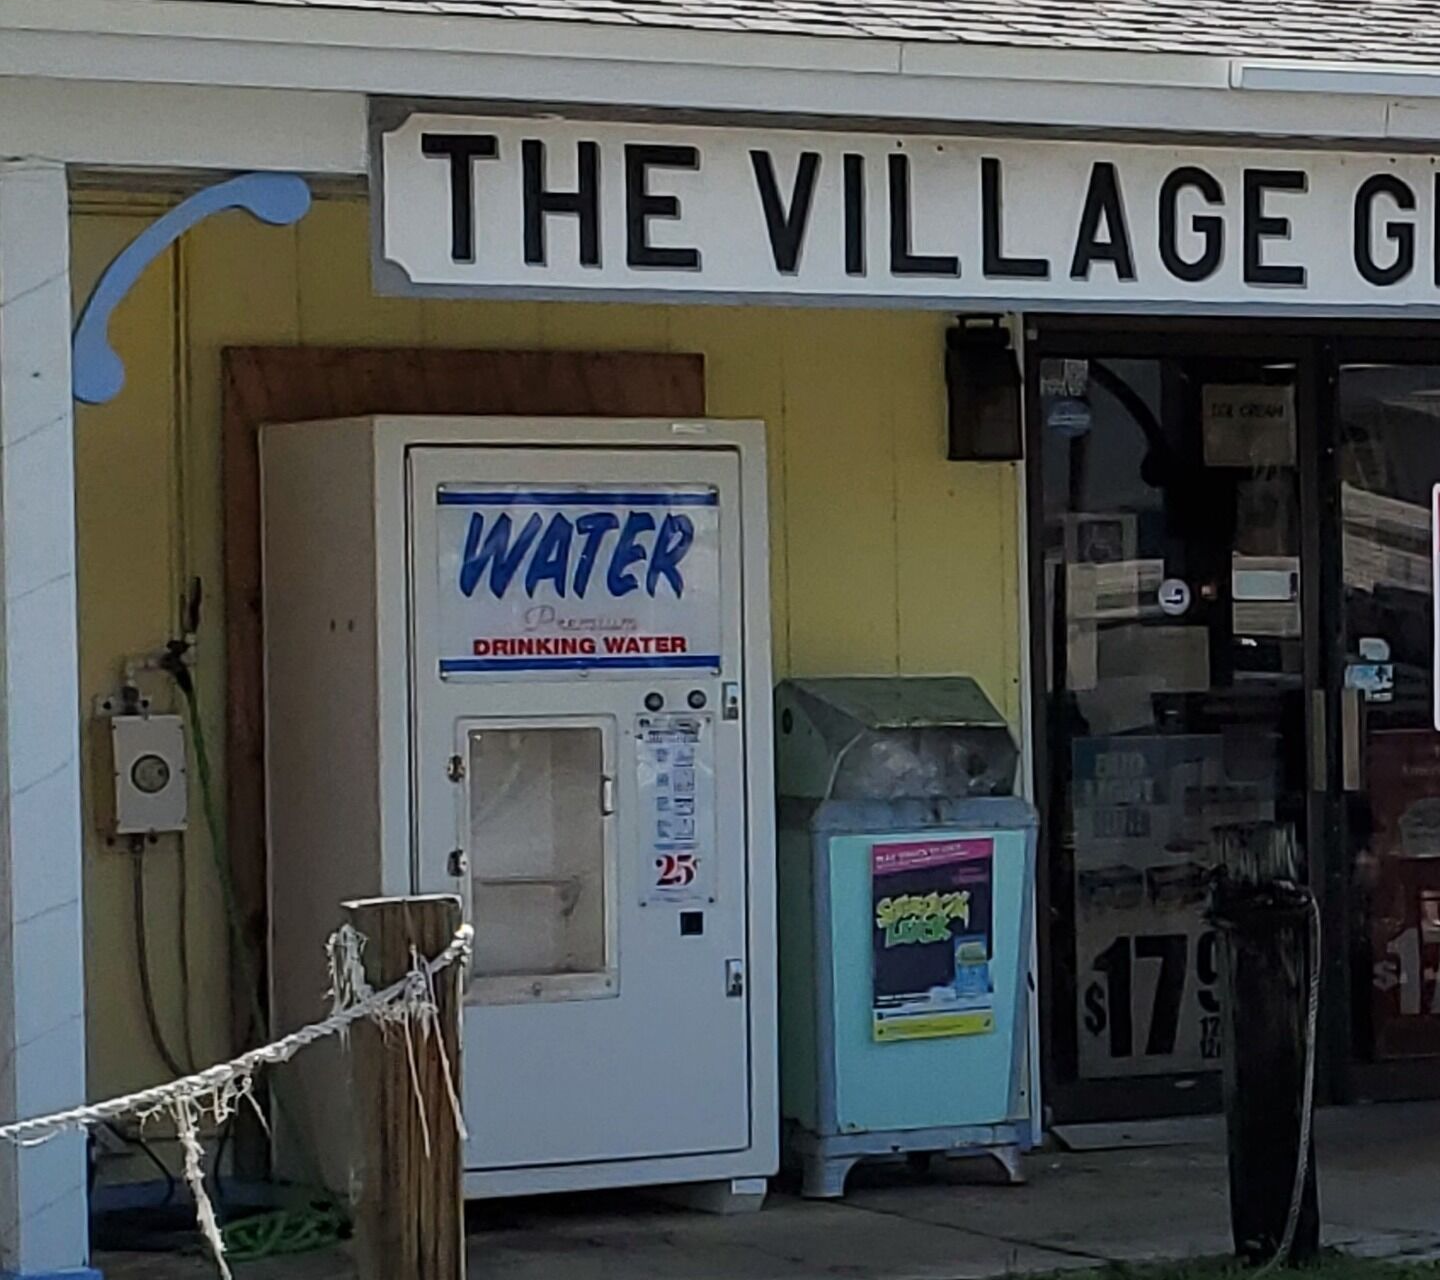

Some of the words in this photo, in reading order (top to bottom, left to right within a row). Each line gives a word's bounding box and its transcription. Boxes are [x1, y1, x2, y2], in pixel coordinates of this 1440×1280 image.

[421, 132, 699, 271] THE
[749, 149, 1309, 286] VILLAGE
[460, 511, 695, 600] WATER
[472, 639, 597, 657] DRINKING
[603, 636, 688, 655] WATER
[523, 604, 639, 633] Premium
